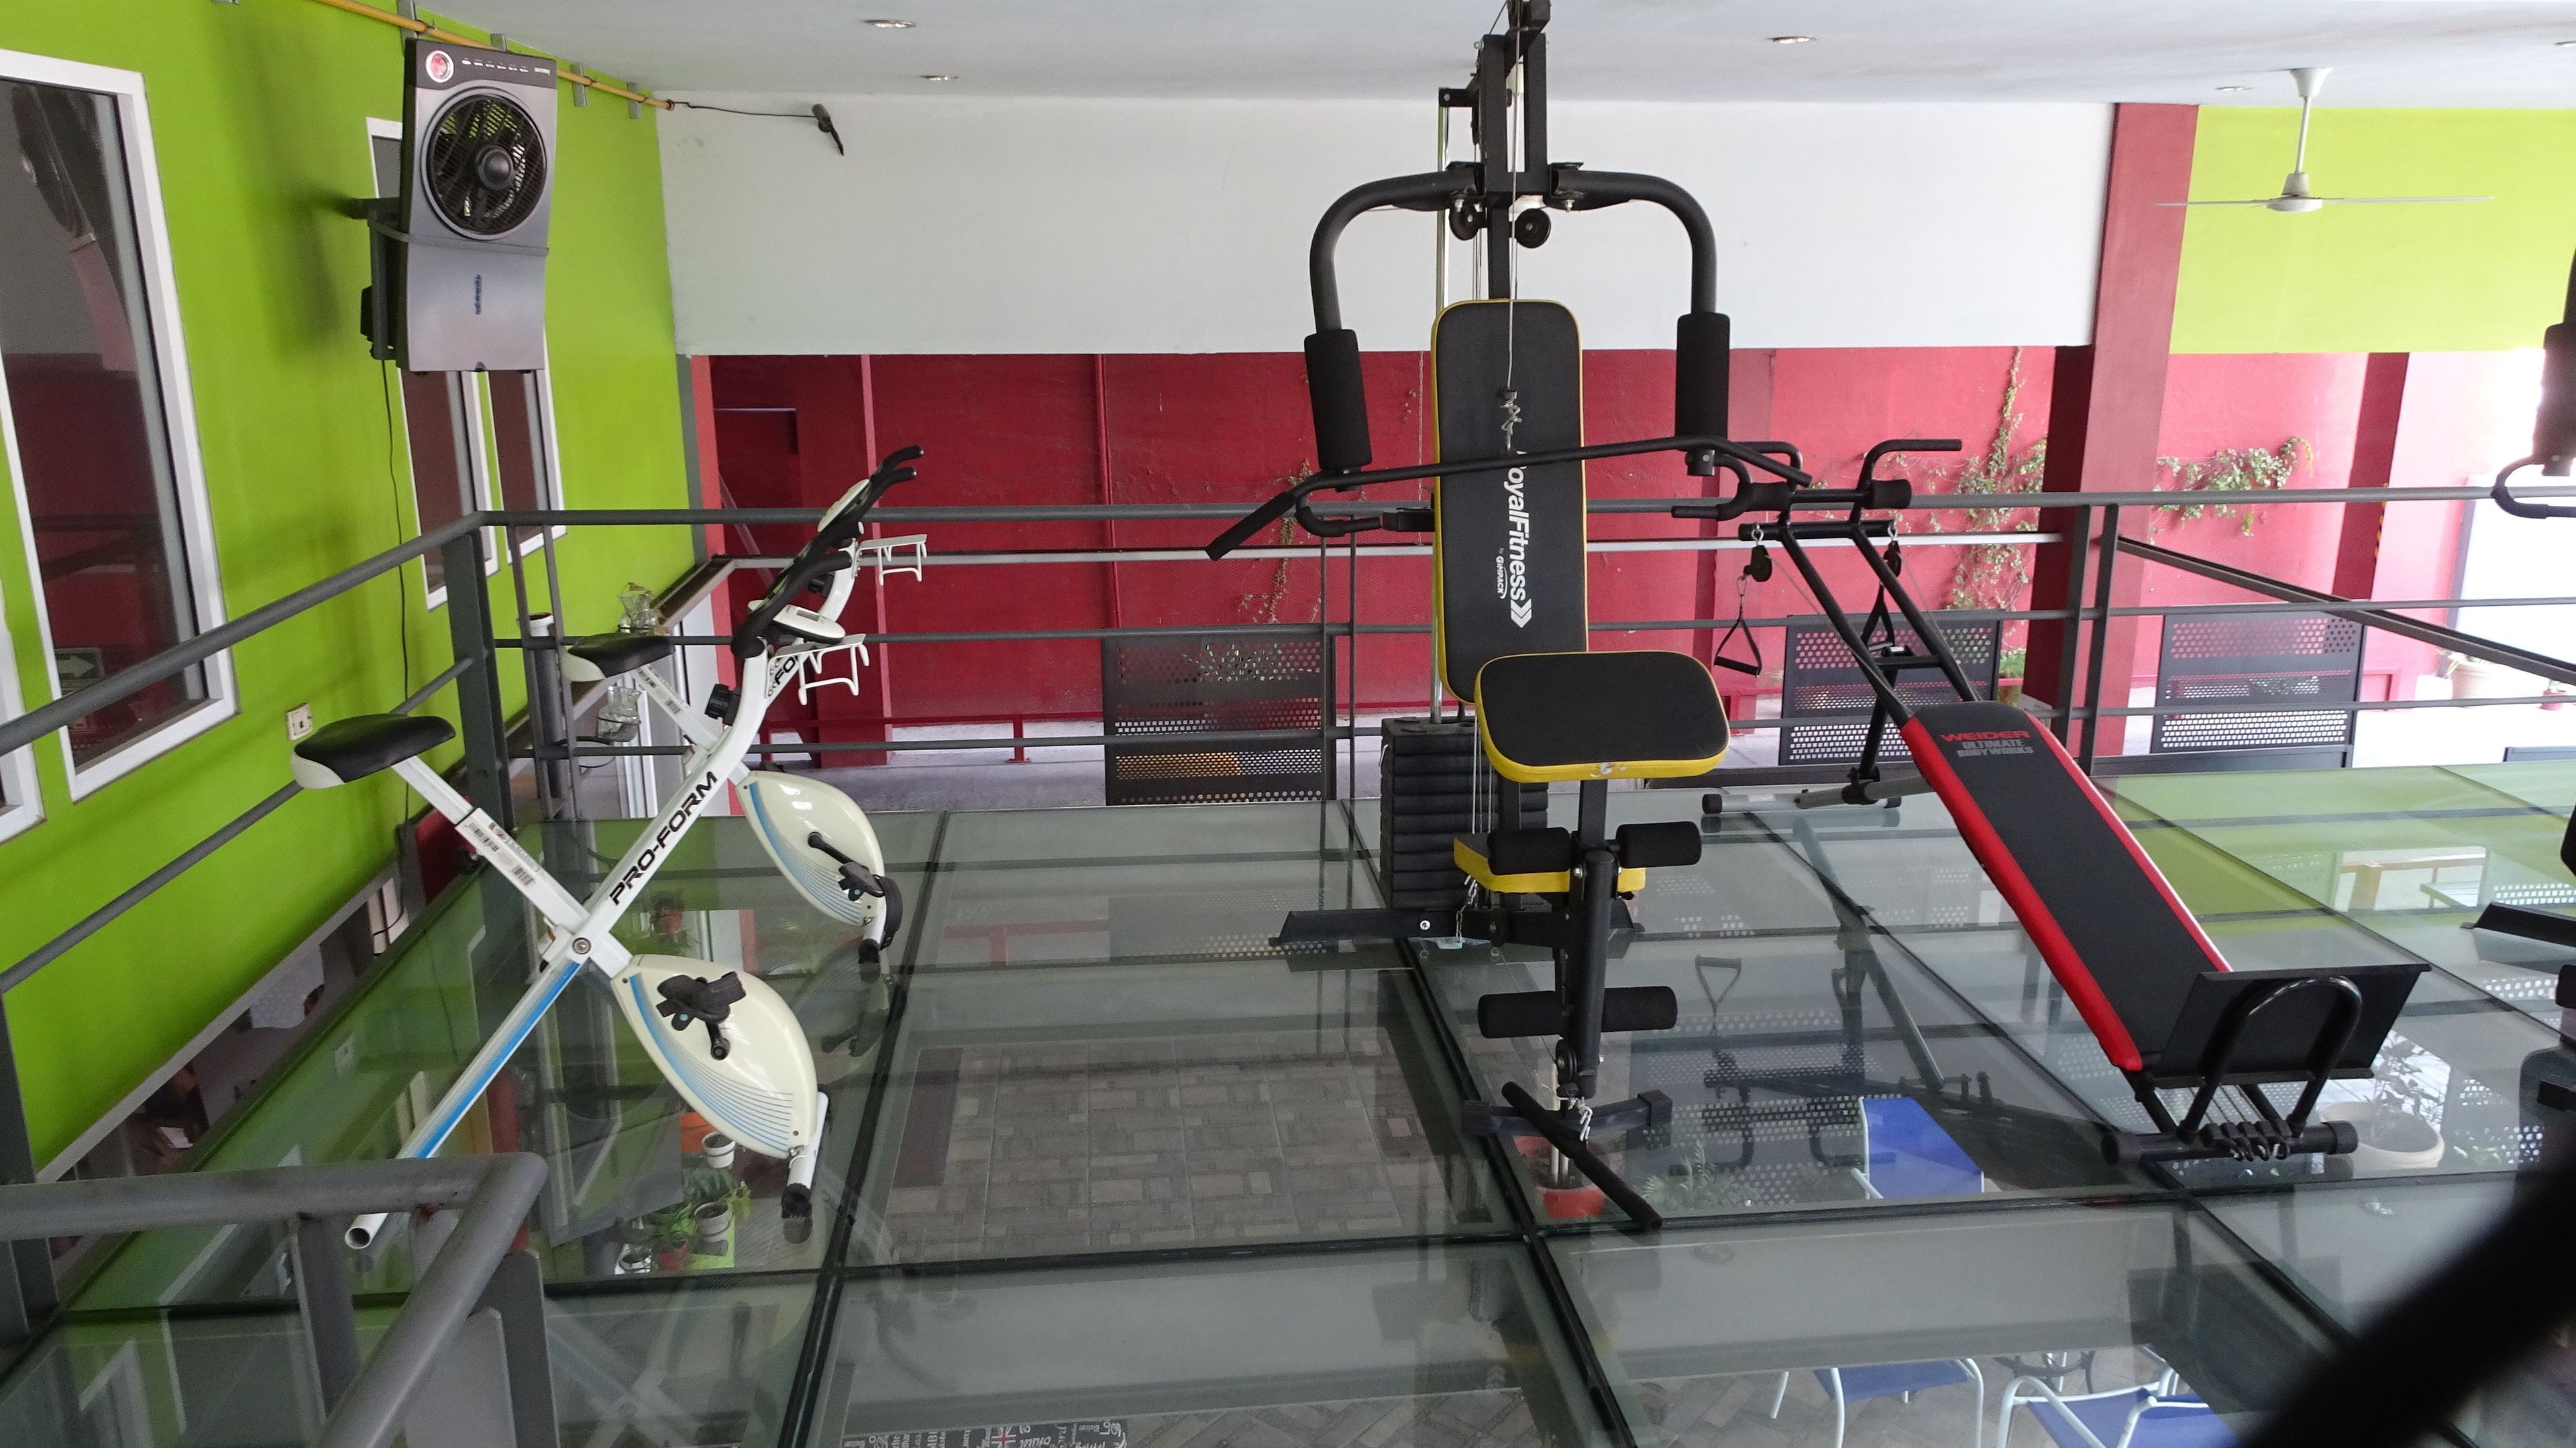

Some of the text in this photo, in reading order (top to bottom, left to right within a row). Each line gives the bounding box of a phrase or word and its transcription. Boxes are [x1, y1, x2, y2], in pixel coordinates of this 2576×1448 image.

[1503, 450, 1530, 601] oyalFitness
[1495, 556, 1505, 594] GIMPACK
[1939, 730, 2031, 741] WEIDER
[1962, 739, 2027, 749] ULTIMATE
[609, 771, 718, 905] PRO-FORM
